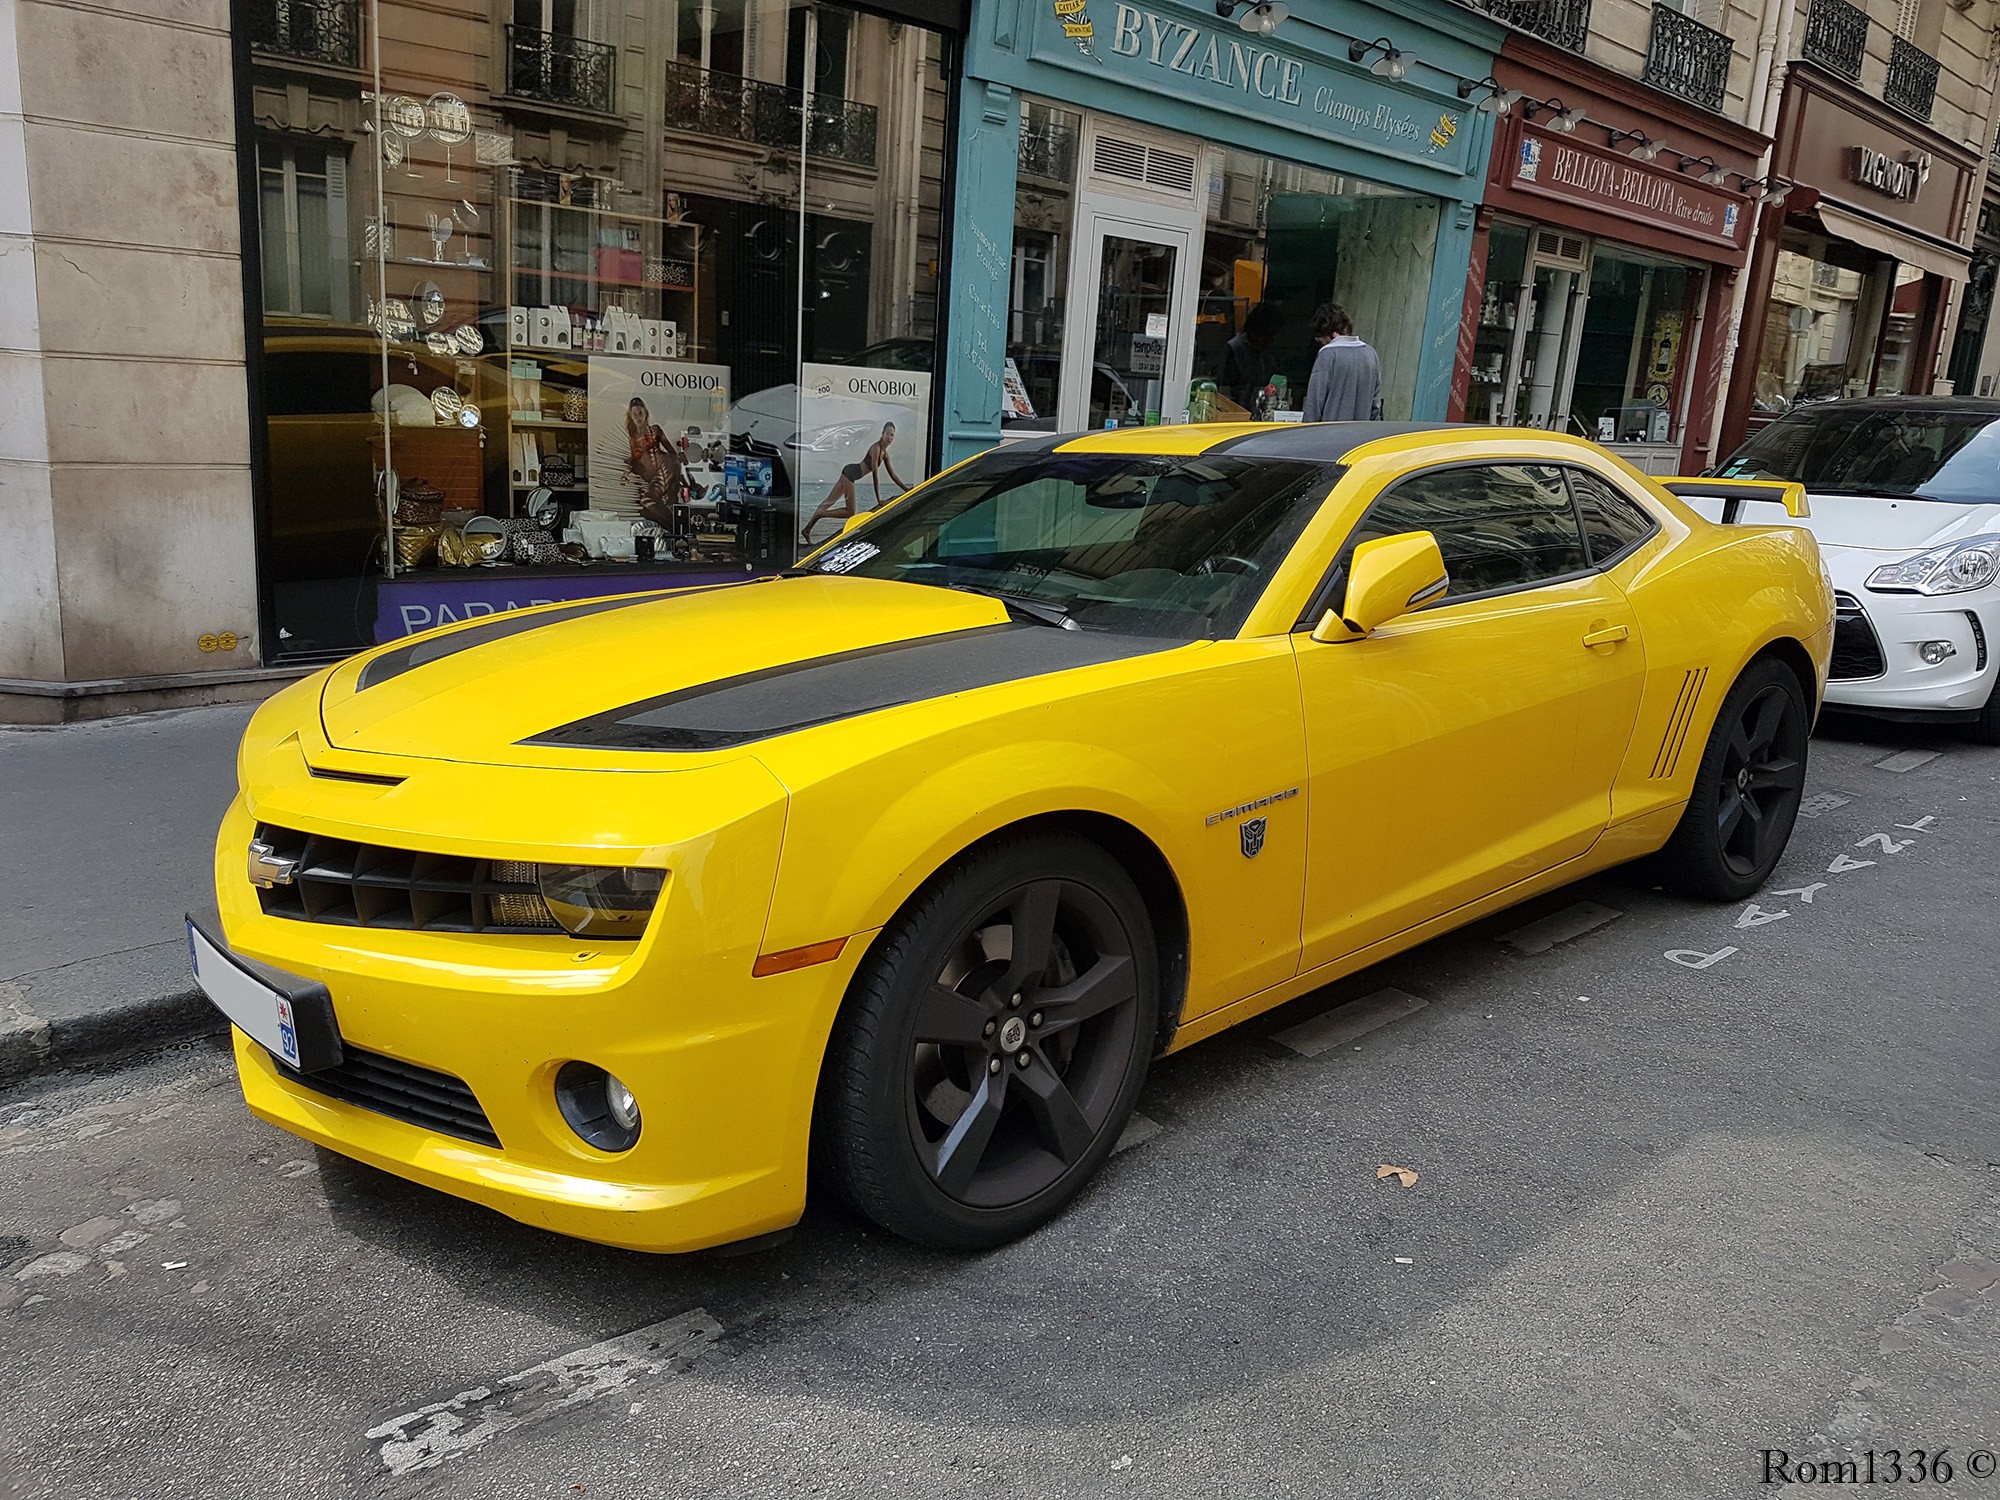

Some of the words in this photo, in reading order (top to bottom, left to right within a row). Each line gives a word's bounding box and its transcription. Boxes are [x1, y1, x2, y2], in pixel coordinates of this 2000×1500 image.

[1110, 2, 1305, 107] BYZANCE
[1314, 85, 1371, 132] Champs
[1372, 103, 1421, 141] Elysées
[1552, 147, 1676, 214] BELLOTA-BELLOTA
[1675, 196, 1693, 220] Rive
[1692, 204, 1715, 227] droite
[641, 371, 724, 391] OENOBIOL
[848, 378, 920, 397] OENOBIOL
[1205, 786, 1299, 827] CAMARO
[1663, 814, 1936, 970] PAYANT
[282, 1029, 297, 1056] 92
